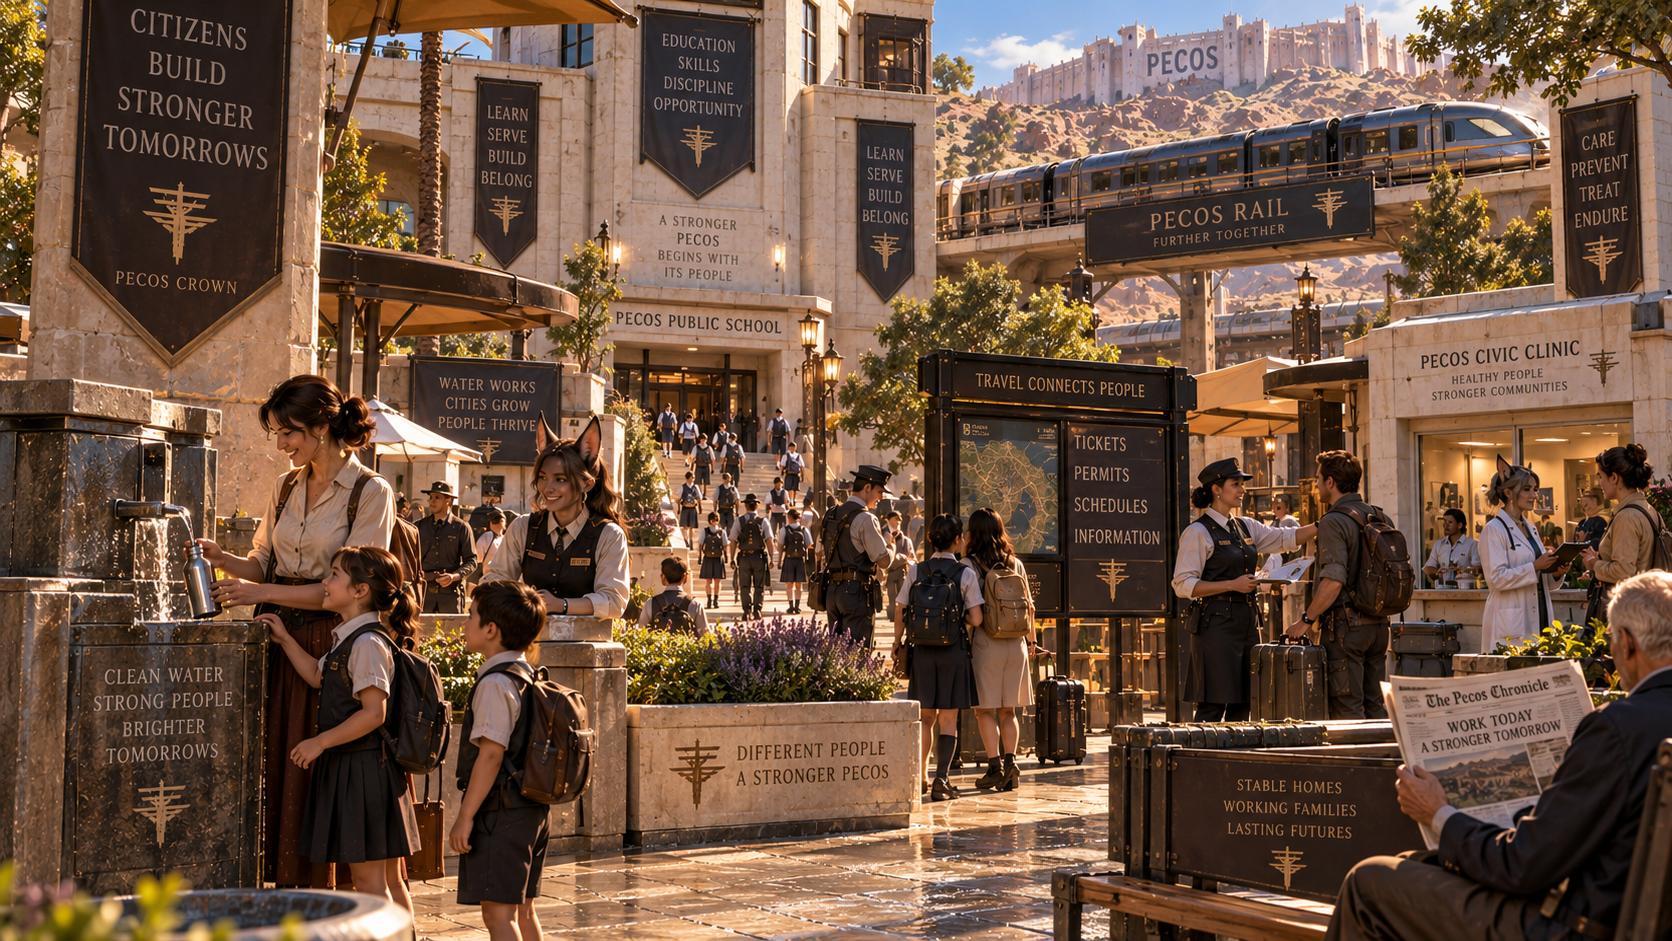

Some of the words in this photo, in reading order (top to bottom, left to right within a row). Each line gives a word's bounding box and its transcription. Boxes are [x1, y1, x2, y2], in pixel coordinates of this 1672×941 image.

[130, 8, 247, 51] CITIZENS
[662, 33, 736, 54] EDUCATION
[148, 51, 226, 86] BUILD
[678, 56, 720, 73] SKILLS
[1147, 45, 1218, 76] PECOS
[664, 75, 734, 96] DISCIPLINE
[117, 86, 253, 130] STRONGER
[487, 105, 529, 121] LEARN
[654, 96, 743, 118] OPPORTUNITY
[487, 127, 527, 144] SERVE
[1581, 130, 1616, 151] CARE
[103, 124, 268, 171] TOMORROWS
[867, 145, 904, 162] LEARN
[488, 149, 526, 166] BUILD
[1570, 153, 1629, 179] PREVENT
[481, 170, 533, 189] BELONG
[867, 167, 903, 184] SERVE
[868, 188, 903, 204] BUILD
[1579, 180, 1621, 201] TREAT
[659, 214, 667, 226] A
[672, 216, 737, 231] STRONGER
[862, 209, 908, 226] BELONG
[1150, 205, 1224, 231] PECOS
[1234, 198, 1289, 222] RAIL
[1574, 204, 1629, 230] ENDURE
[677, 232, 719, 248] PECOS
[1153, 230, 1211, 248] FURTHER
[1216, 223, 1286, 242] TOGETHER
[658, 249, 703, 263] BEGINS
[708, 252, 739, 266] WITH
[115, 271, 168, 289] PECOS
[176, 276, 237, 294] CROWN
[664, 267, 683, 278] ITS
[688, 268, 732, 282] PEOPLE
[616, 311, 662, 326] PECOS
[668, 314, 719, 332] PUBLIC
[726, 318, 782, 335] SCHOOL
[1421, 351, 1469, 369] PECOS
[1476, 346, 1518, 365] CIVIC
[1525, 340, 1580, 359] CLINIC
[439, 376, 484, 392] WATER
[489, 379, 536, 394] WORKS
[976, 373, 1023, 390] TRAVEL
[1028, 376, 1095, 395] CONNECTS
[1100, 381, 1145, 398] PEOPLE
[1452, 373, 1499, 385] HEALTHY
[1503, 368, 1543, 381] PEOPLE
[1432, 388, 1486, 401] STRONGER
[1491, 381, 1568, 396] COMMUNITIES
[445, 397, 486, 411] CITIES
[491, 398, 530, 412] GROW
[438, 416, 485, 430] PEOPLE
[490, 418, 536, 432] THRIVE
[1074, 434, 1126, 452] TICKETS
[1075, 466, 1130, 482] PERMITS
[1074, 497, 1148, 514] SCHEDULES
[1075, 529, 1160, 546] INFORMATION
[104, 668, 160, 685] CLEAN
[168, 667, 223, 683] WATER
[93, 694, 164, 712] STRONG
[172, 692, 233, 709] PEOPLE
[1425, 693, 1450, 708] The
[1452, 690, 1488, 706] Pecos
[1490, 678, 1550, 699] Chronicle
[123, 719, 205, 737] BRIGHTER
[1447, 717, 1487, 733] WORK
[1490, 709, 1533, 727] TODAY
[1421, 742, 1429, 753] A
[1432, 733, 1491, 752] STRONGER
[1494, 719, 1562, 742] TOMORROW
[106, 743, 219, 764] TOMORROWS
[737, 743, 823, 761] DIFFERENT
[830, 741, 886, 757] PEOPLE
[736, 771, 746, 786] A
[753, 766, 835, 786] STRONGER
[842, 765, 889, 781] PECOS
[1237, 779, 1286, 792] STABLE
[1293, 781, 1342, 794] HOMES
[1224, 800, 1288, 814] WORKING
[1295, 803, 1357, 817] FAMILIES
[1228, 822, 1284, 836] LASTING
[1291, 825, 1352, 839] FUTURES
